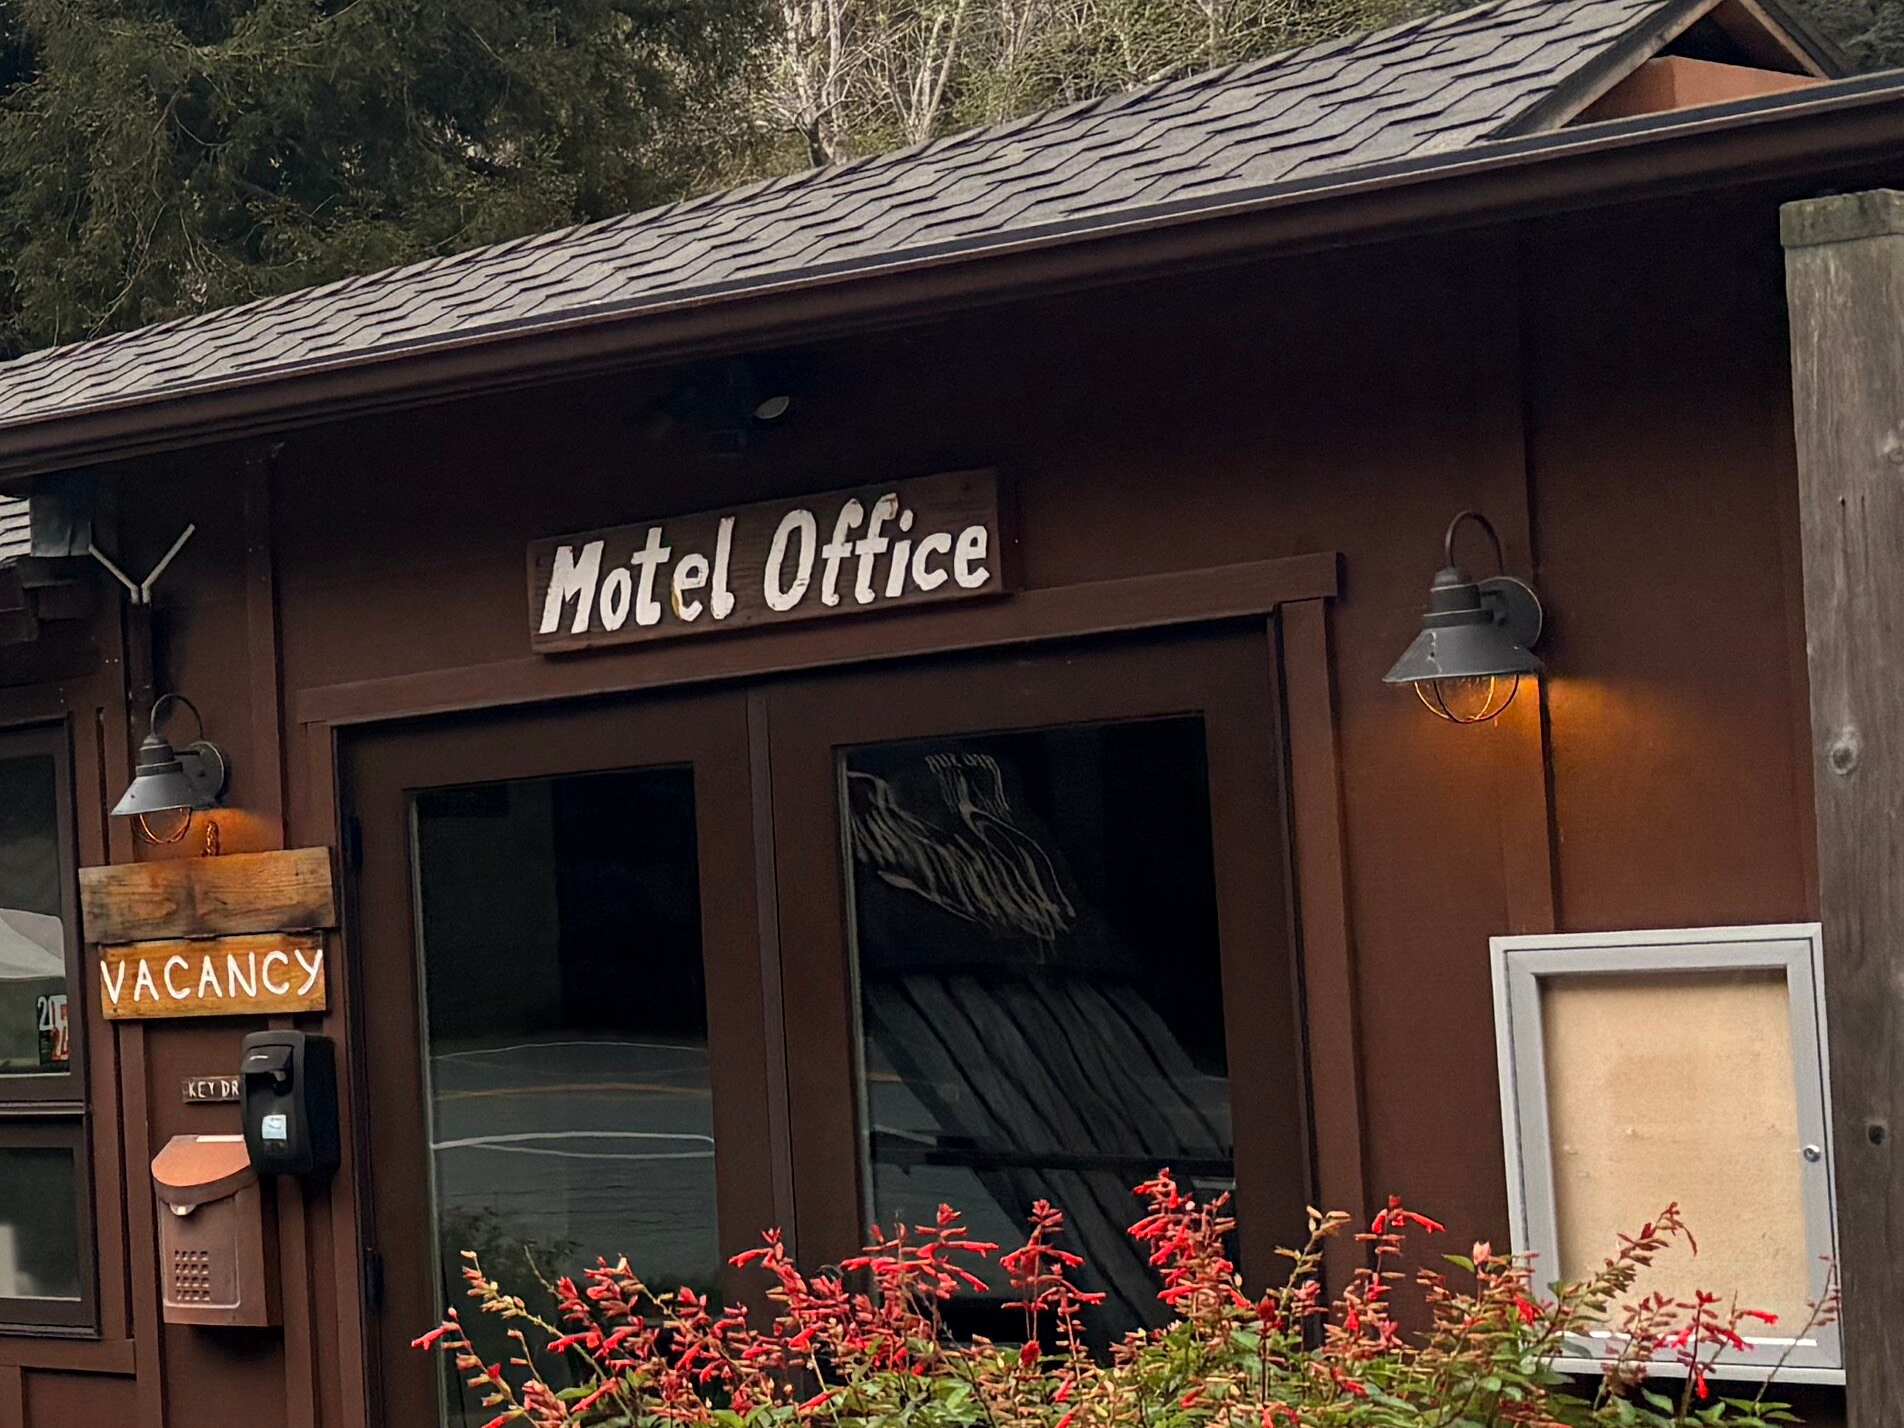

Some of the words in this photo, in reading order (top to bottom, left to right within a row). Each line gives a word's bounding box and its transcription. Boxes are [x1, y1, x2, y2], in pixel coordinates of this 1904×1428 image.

[539, 516, 735, 634] Motel
[763, 492, 990, 612] Office
[100, 948, 325, 1005] VACANCY
[188, 1080, 215, 1098] KEY
[220, 1079, 240, 1098] DR
